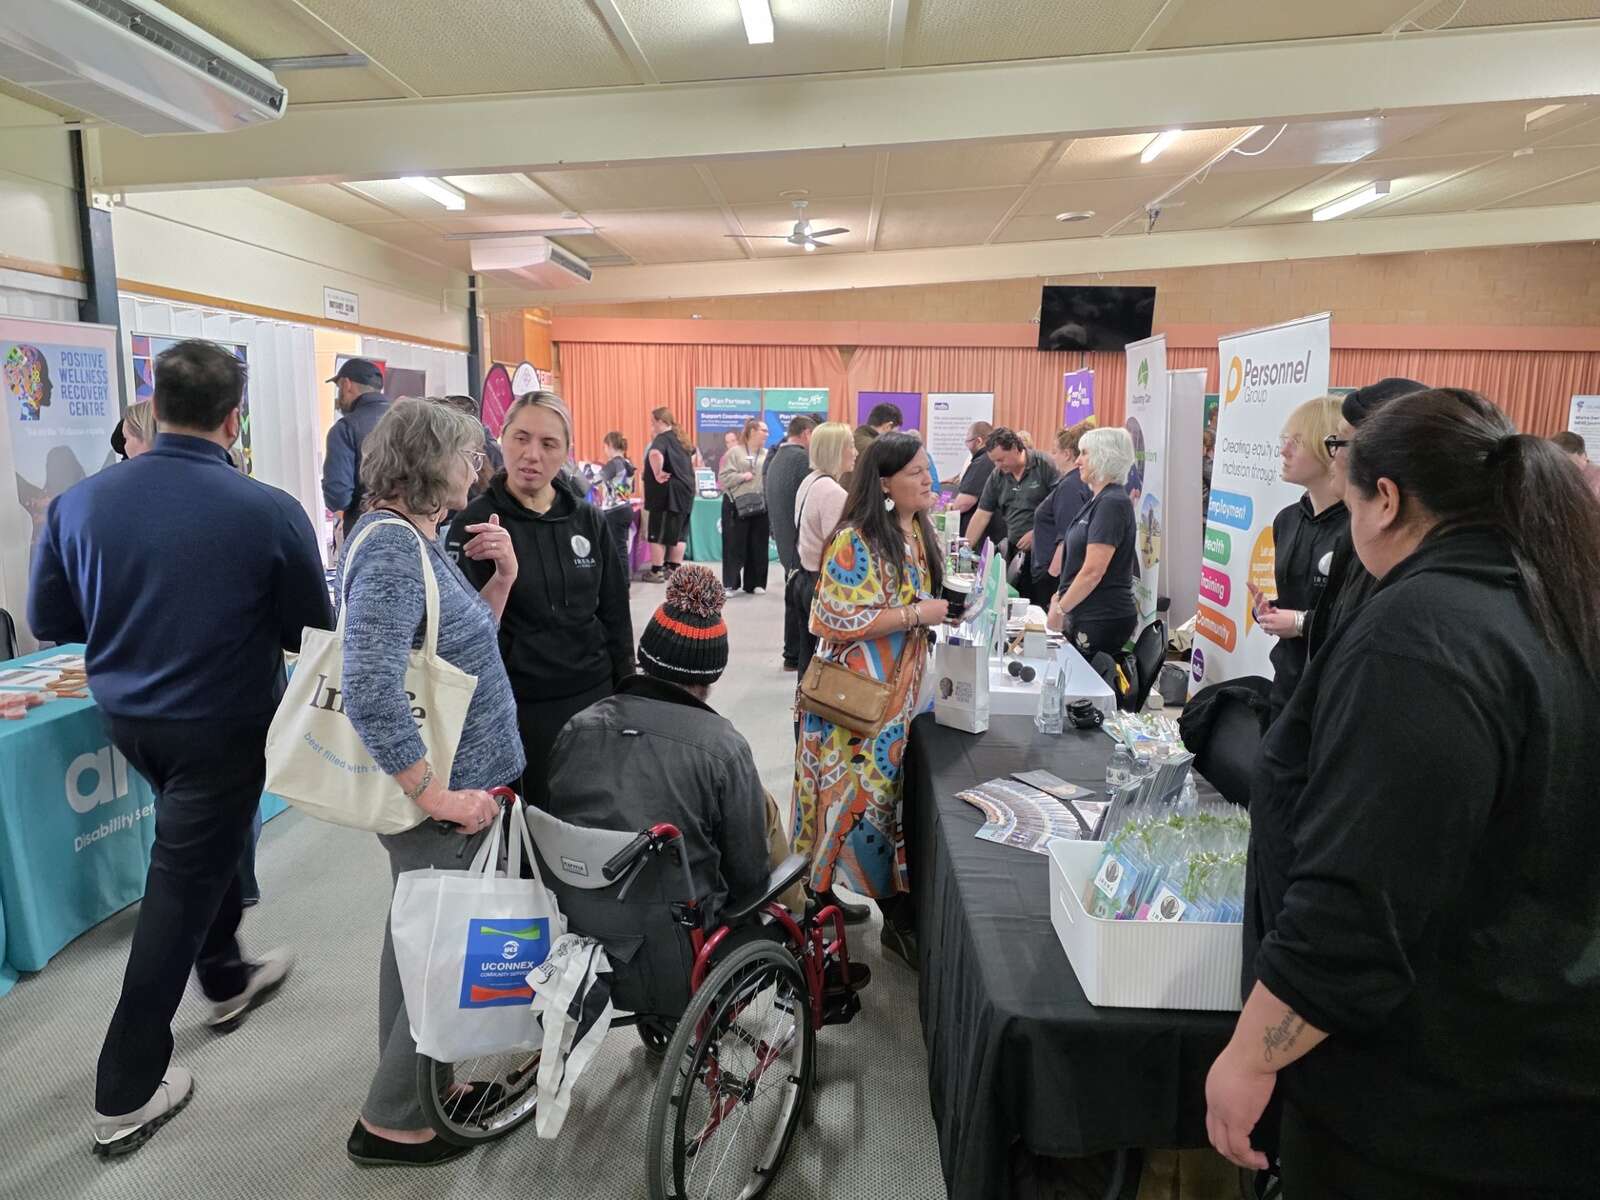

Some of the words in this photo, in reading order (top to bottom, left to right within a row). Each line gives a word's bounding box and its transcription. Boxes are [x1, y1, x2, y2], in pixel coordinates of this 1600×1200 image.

[61, 351, 104, 368] POSITIVE
[1243, 349, 1312, 386] Personnel
[59, 368, 108, 384] WELLNESS
[60, 384, 108, 400] RECOVERY
[1244, 385, 1267, 407] Group
[68, 401, 106, 416] CENTRE
[1222, 437, 1250, 459] Creating
[1251, 441, 1272, 459] equity
[75, 812, 134, 853] Disability
[135, 802, 155, 820] ser
[481, 961, 534, 971] UCONNEX
